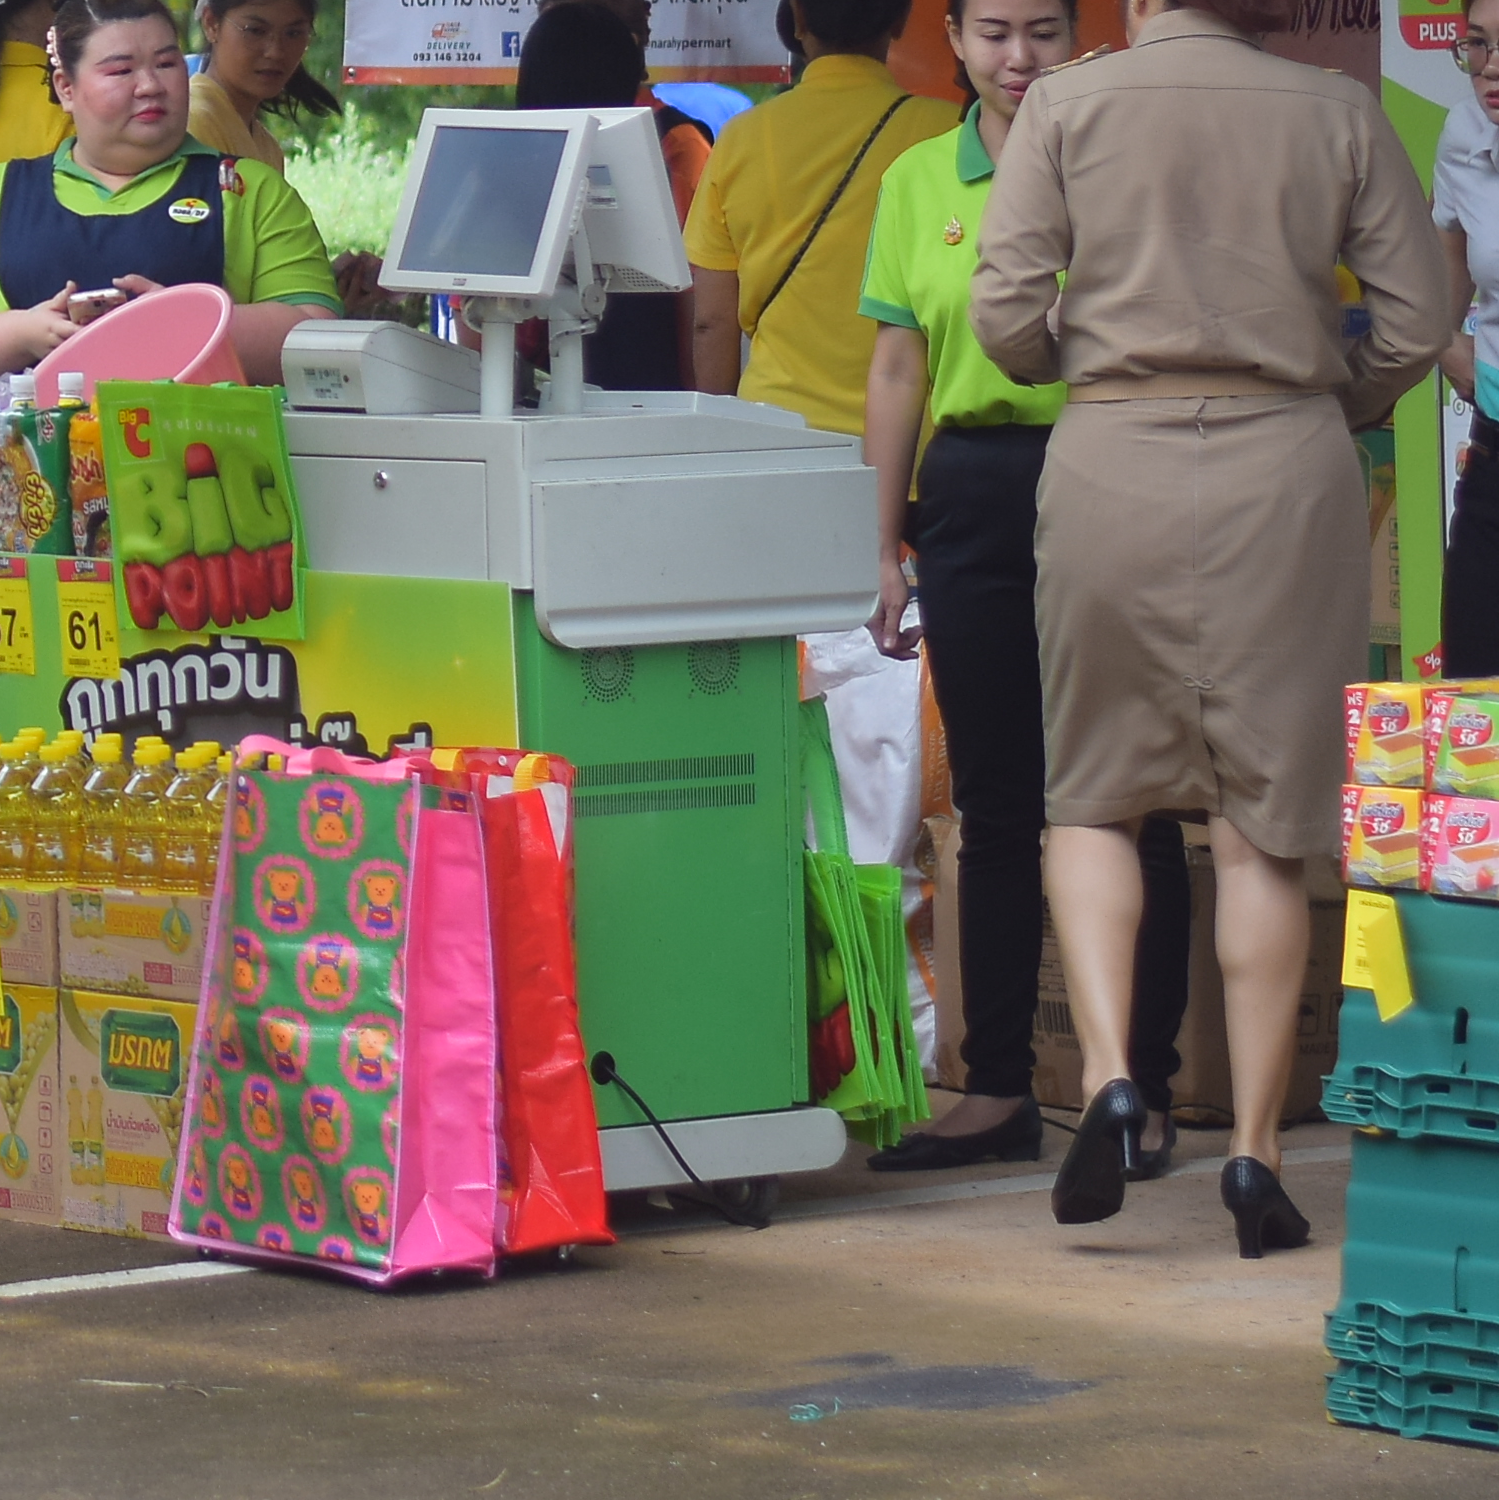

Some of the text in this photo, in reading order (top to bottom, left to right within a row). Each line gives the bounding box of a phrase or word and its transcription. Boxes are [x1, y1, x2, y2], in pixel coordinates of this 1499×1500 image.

[1419, 23, 1456, 41] PLUS
[427, 42, 471, 50] DELIVERY
[413, 52, 481, 61] 093 146 3204
[122, 542, 293, 631] POINT
[68, 610, 102, 651] 61
[1348, 708, 1360, 724] 2
[1432, 717, 1442, 733] 2
[1343, 807, 1354, 823] 2
[1429, 817, 1440, 833] 2
[107, 1032, 173, 1073] มรกต
